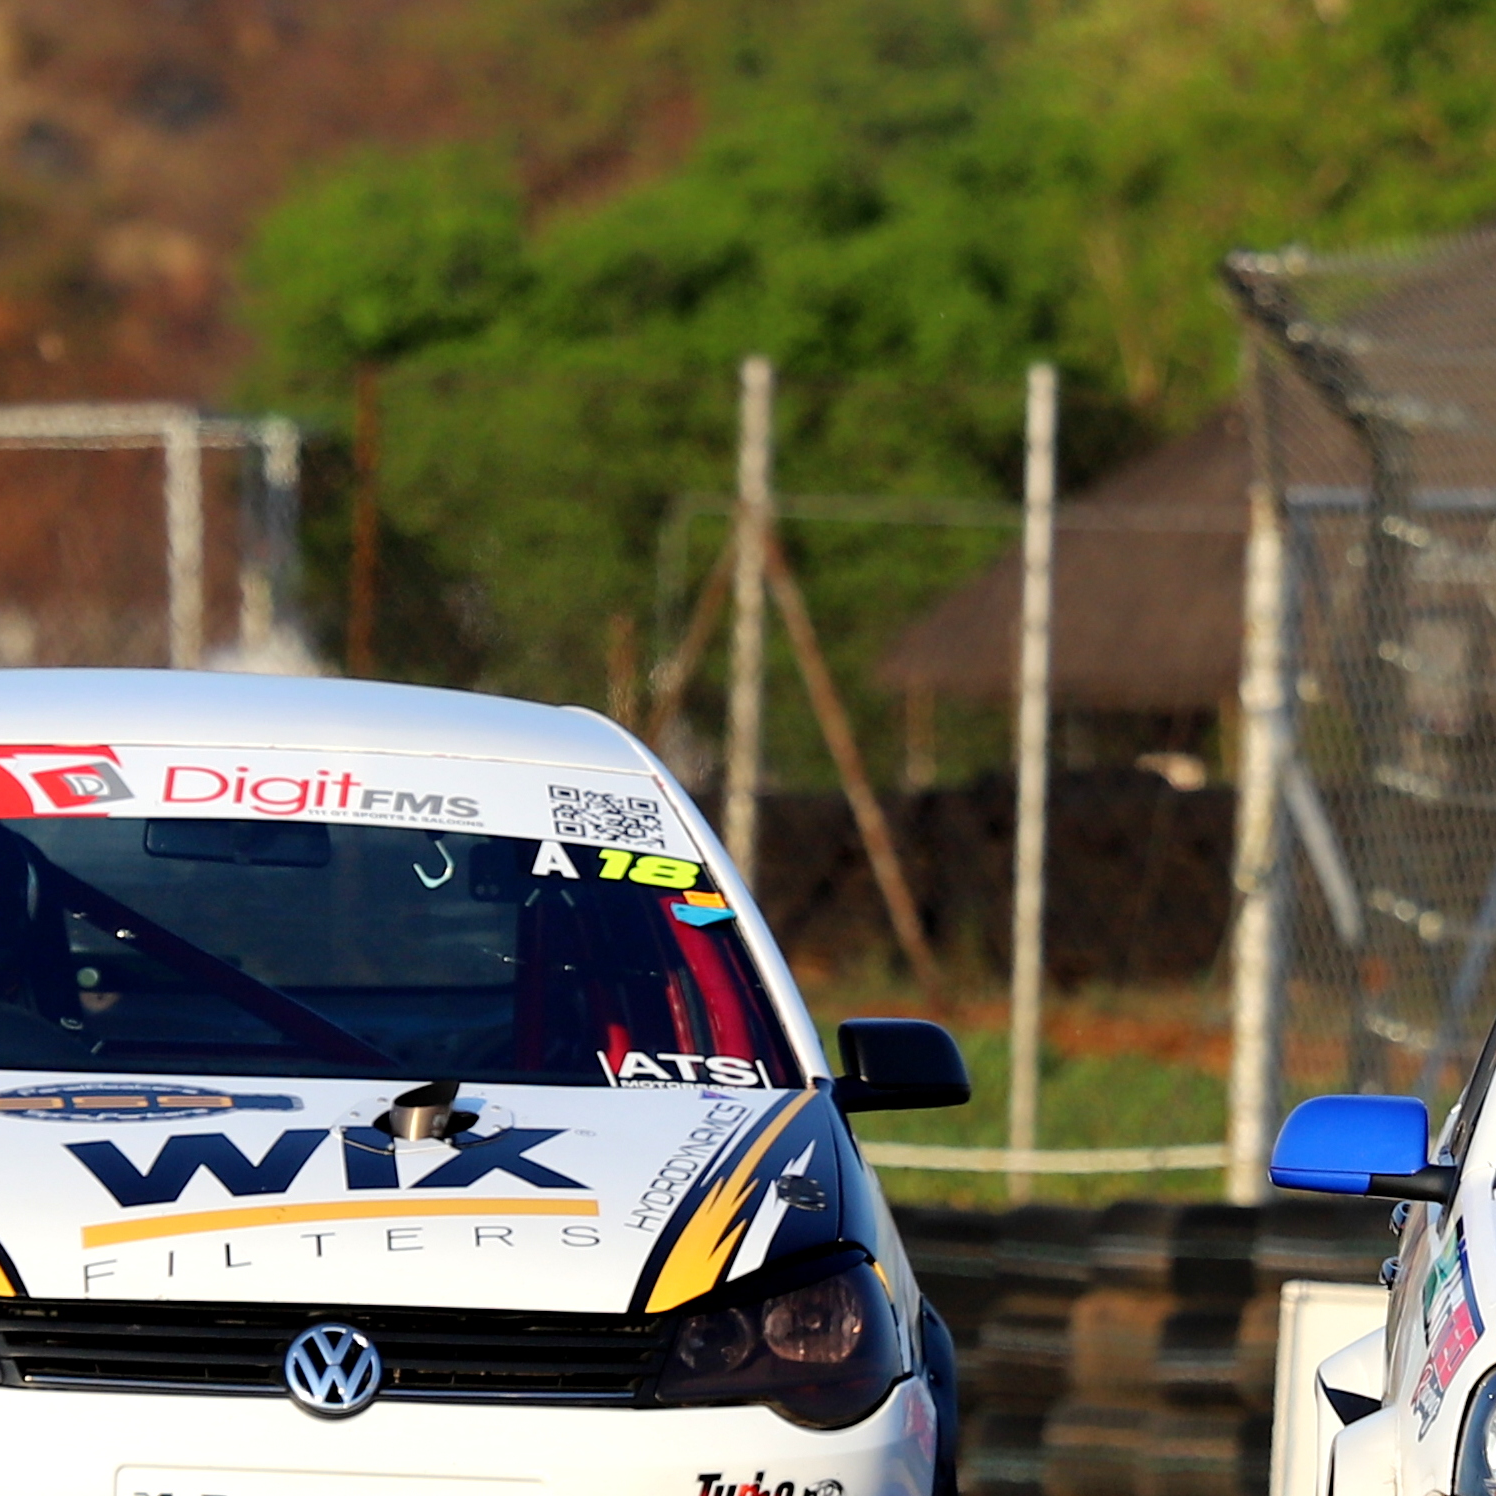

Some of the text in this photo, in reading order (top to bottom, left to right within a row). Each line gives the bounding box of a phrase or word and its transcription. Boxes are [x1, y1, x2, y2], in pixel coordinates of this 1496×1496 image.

[162, 766, 480, 817] DigitFMS
[352, 812, 405, 821] SPORTS
[421, 817, 485, 828] SALOONS
[532, 840, 700, 889] A 18
[617, 1051, 760, 1086] ATS
[62, 1128, 595, 1209] WIX
[81, 1224, 602, 1292] FILTERS
